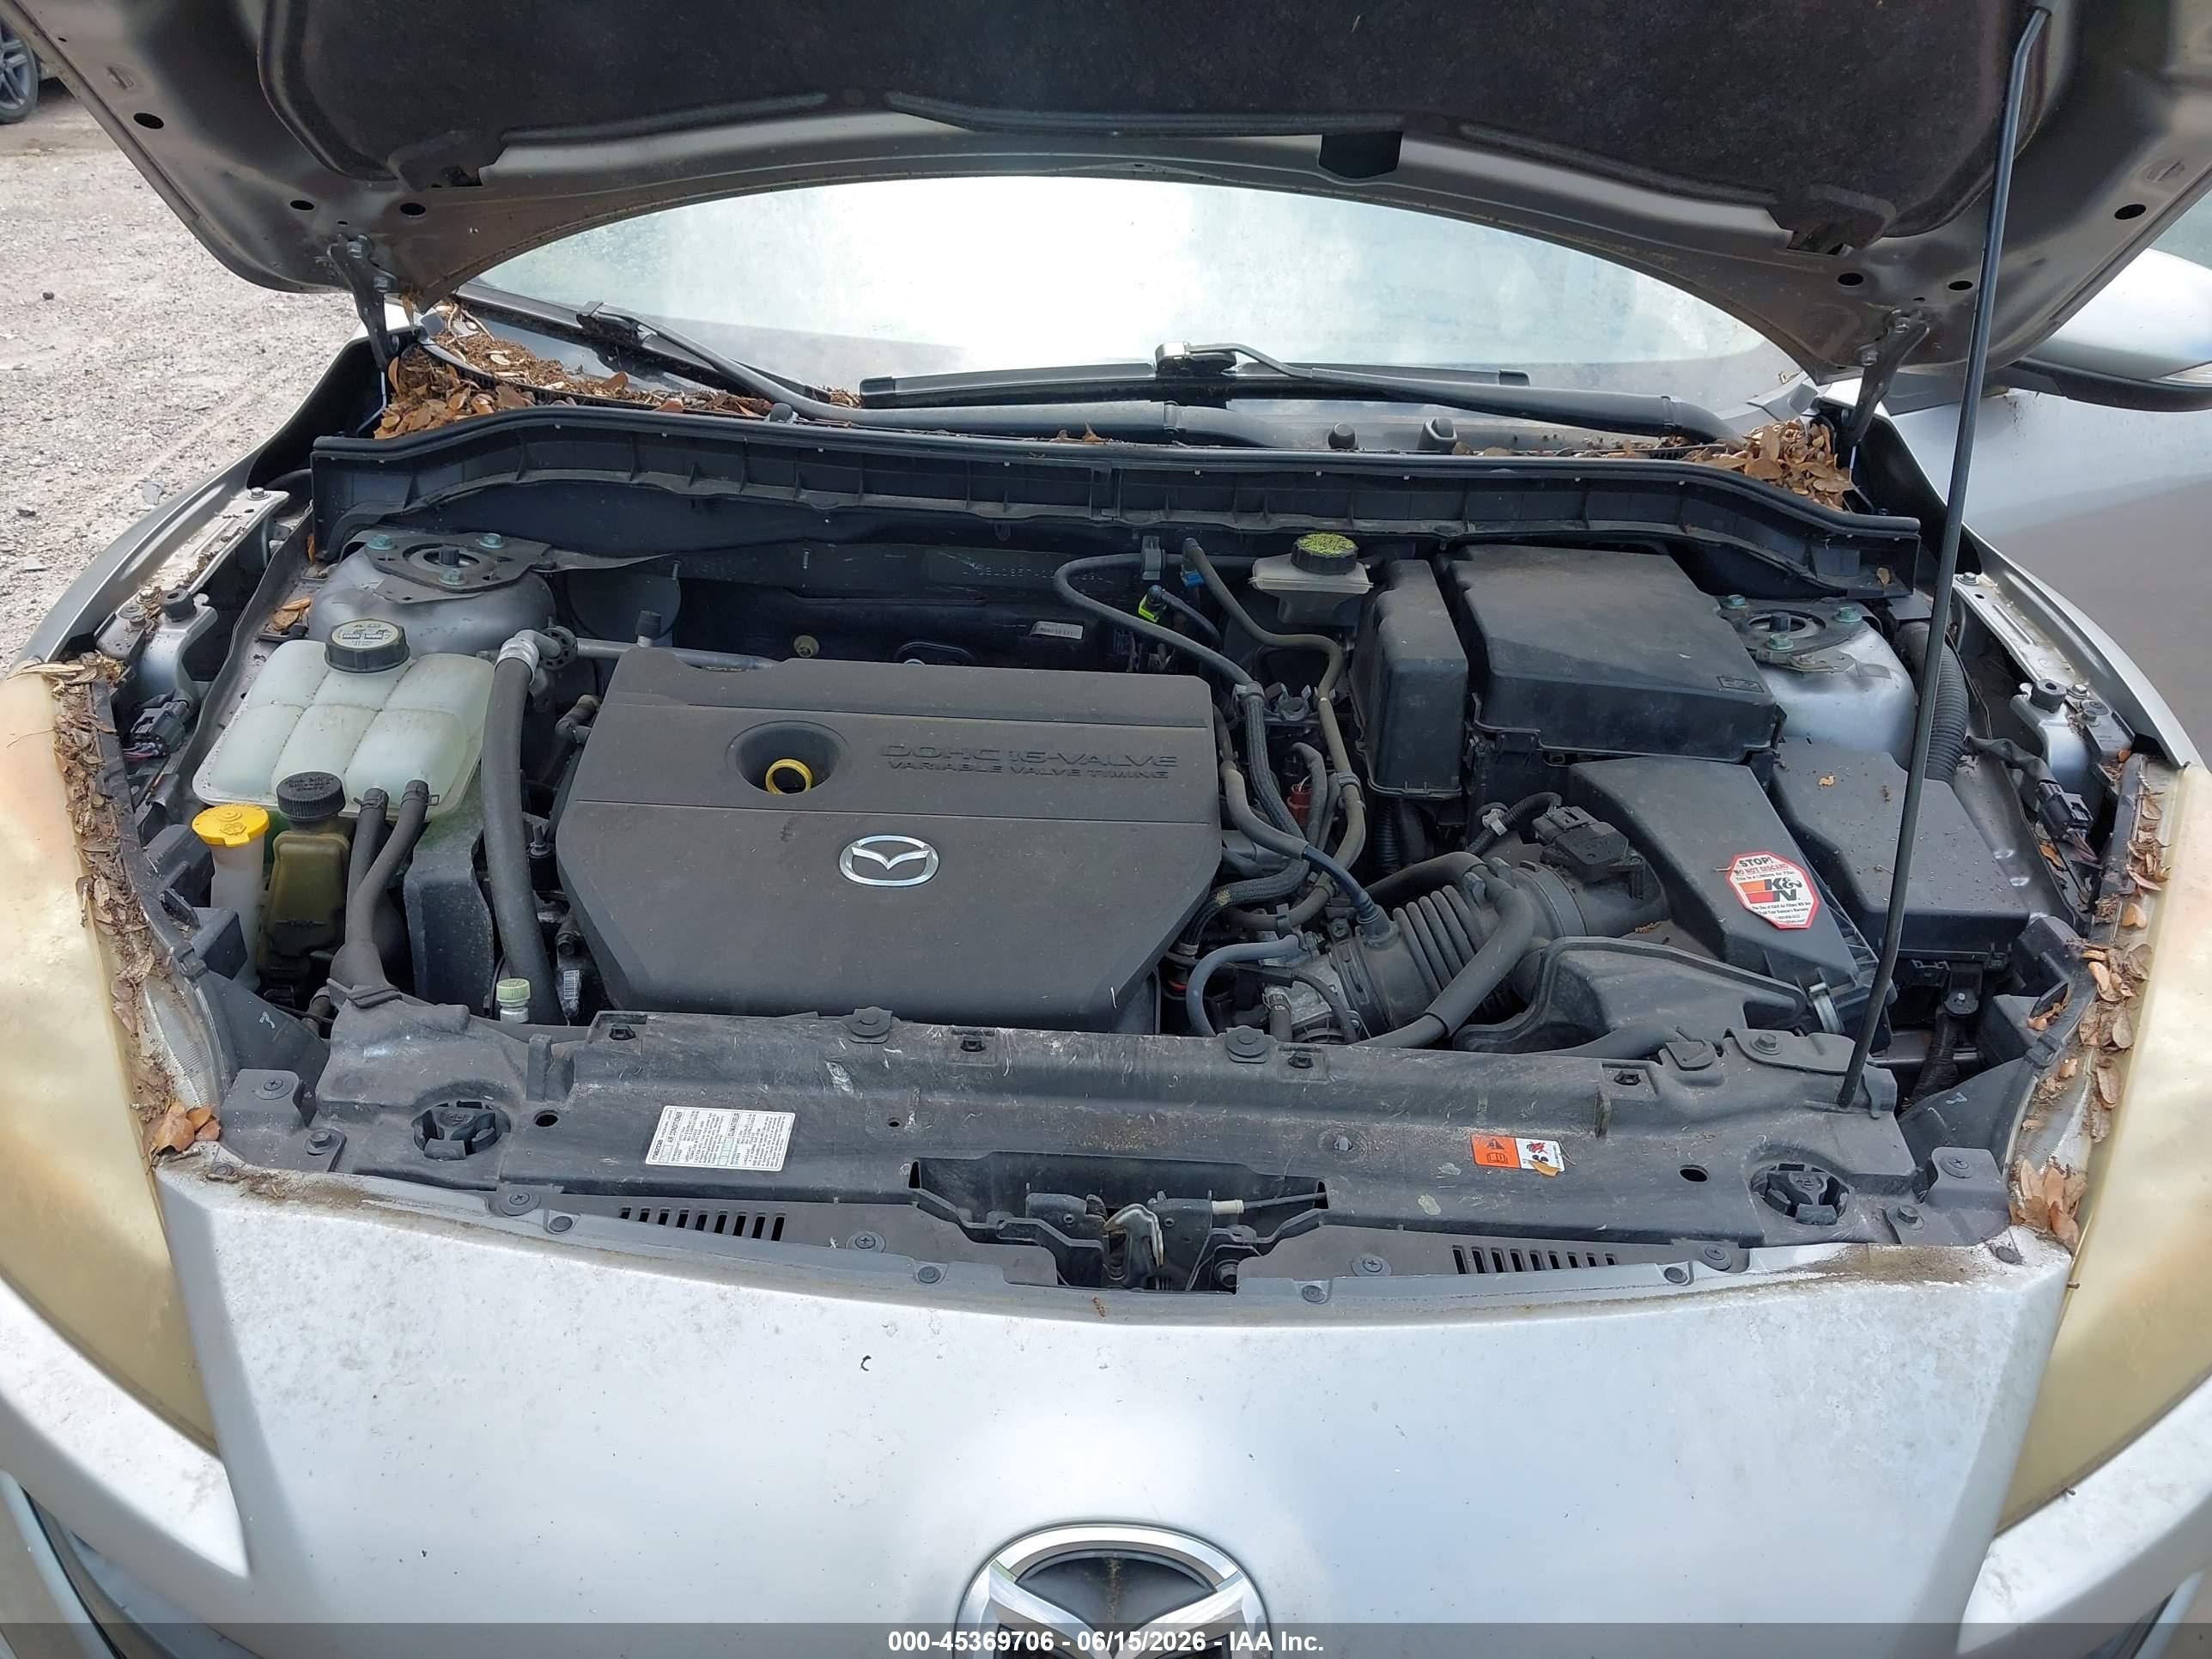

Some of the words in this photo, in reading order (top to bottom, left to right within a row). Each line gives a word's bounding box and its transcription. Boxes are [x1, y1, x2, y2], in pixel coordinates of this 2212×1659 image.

[881, 744, 1001, 762] DOHC
[1008, 749, 1177, 768] 16-VALVE
[888, 761, 1004, 774] VARIABLE
[1010, 765, 1082, 777] VALVE
[1087, 769, 1169, 780] TIMING
[1739, 856, 1774, 867] STOP!
[652, 1139, 664, 1160] mazda
